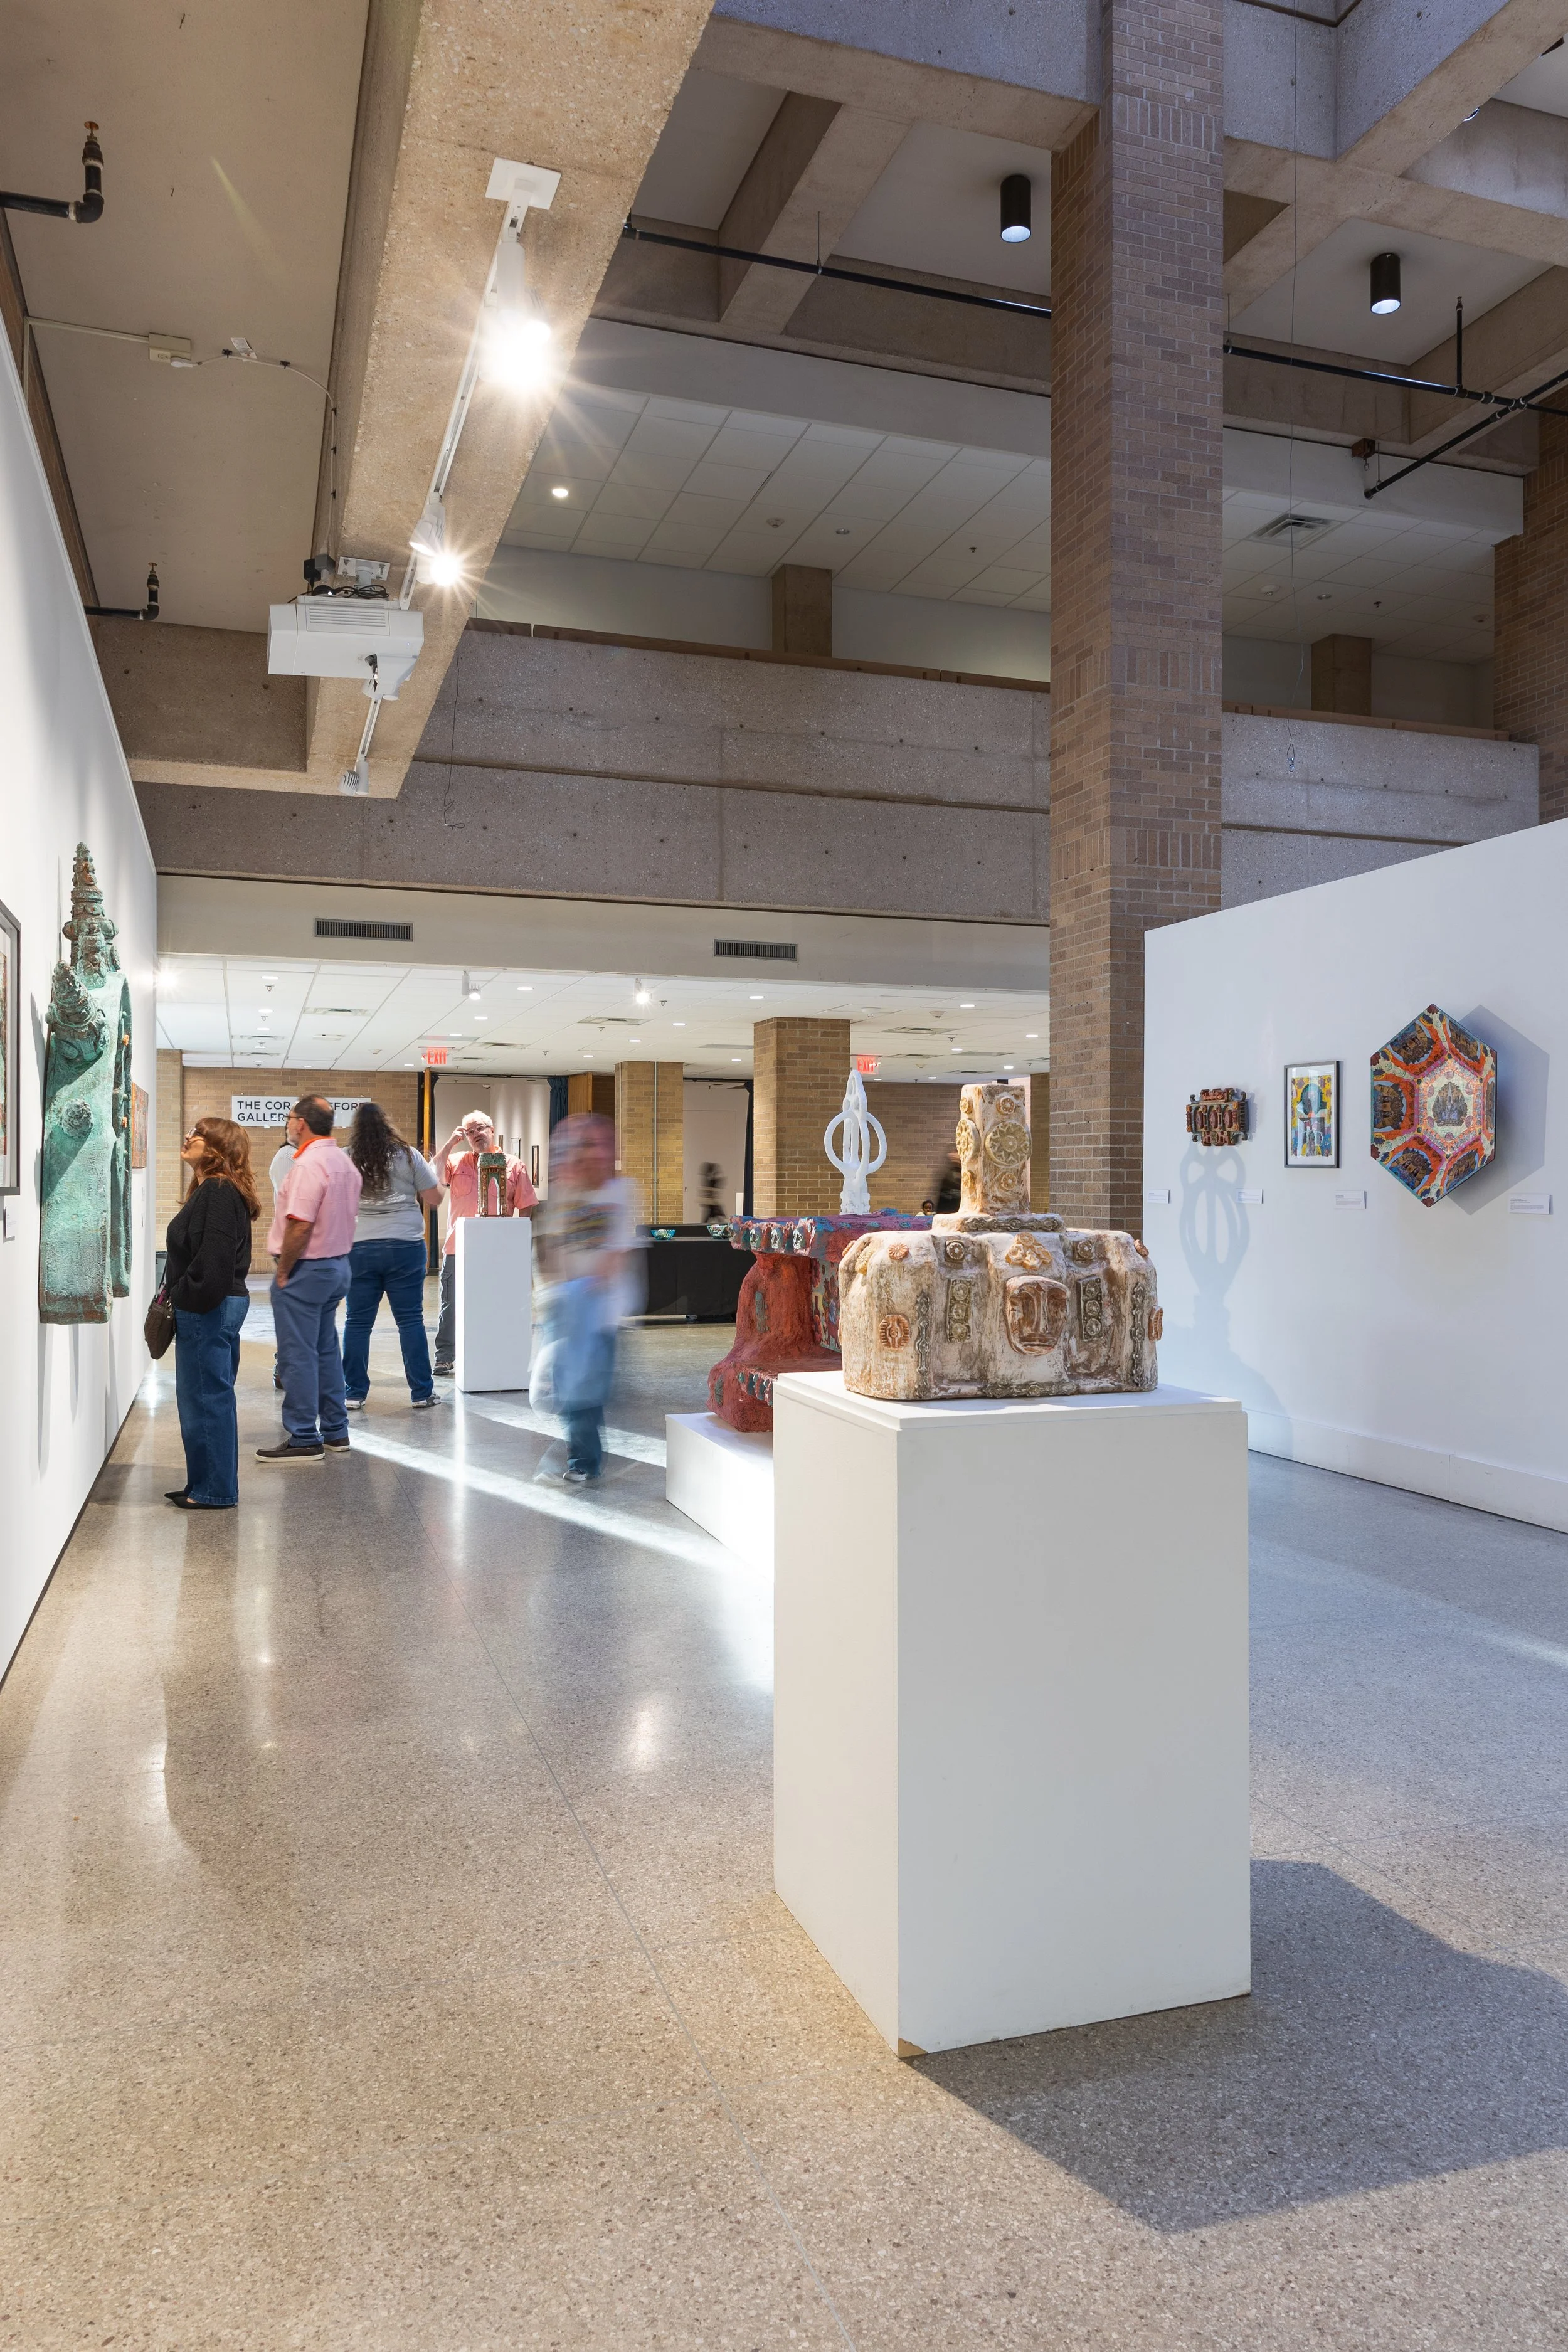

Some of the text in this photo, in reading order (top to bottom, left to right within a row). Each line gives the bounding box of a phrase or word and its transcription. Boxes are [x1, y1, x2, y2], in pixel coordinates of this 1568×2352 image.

[427, 1048, 447, 1064] EXIT
[857, 1057, 875, 1072] EXIT
[237, 1101, 261, 1110] THE
[265, 1101, 291, 1110] COR
